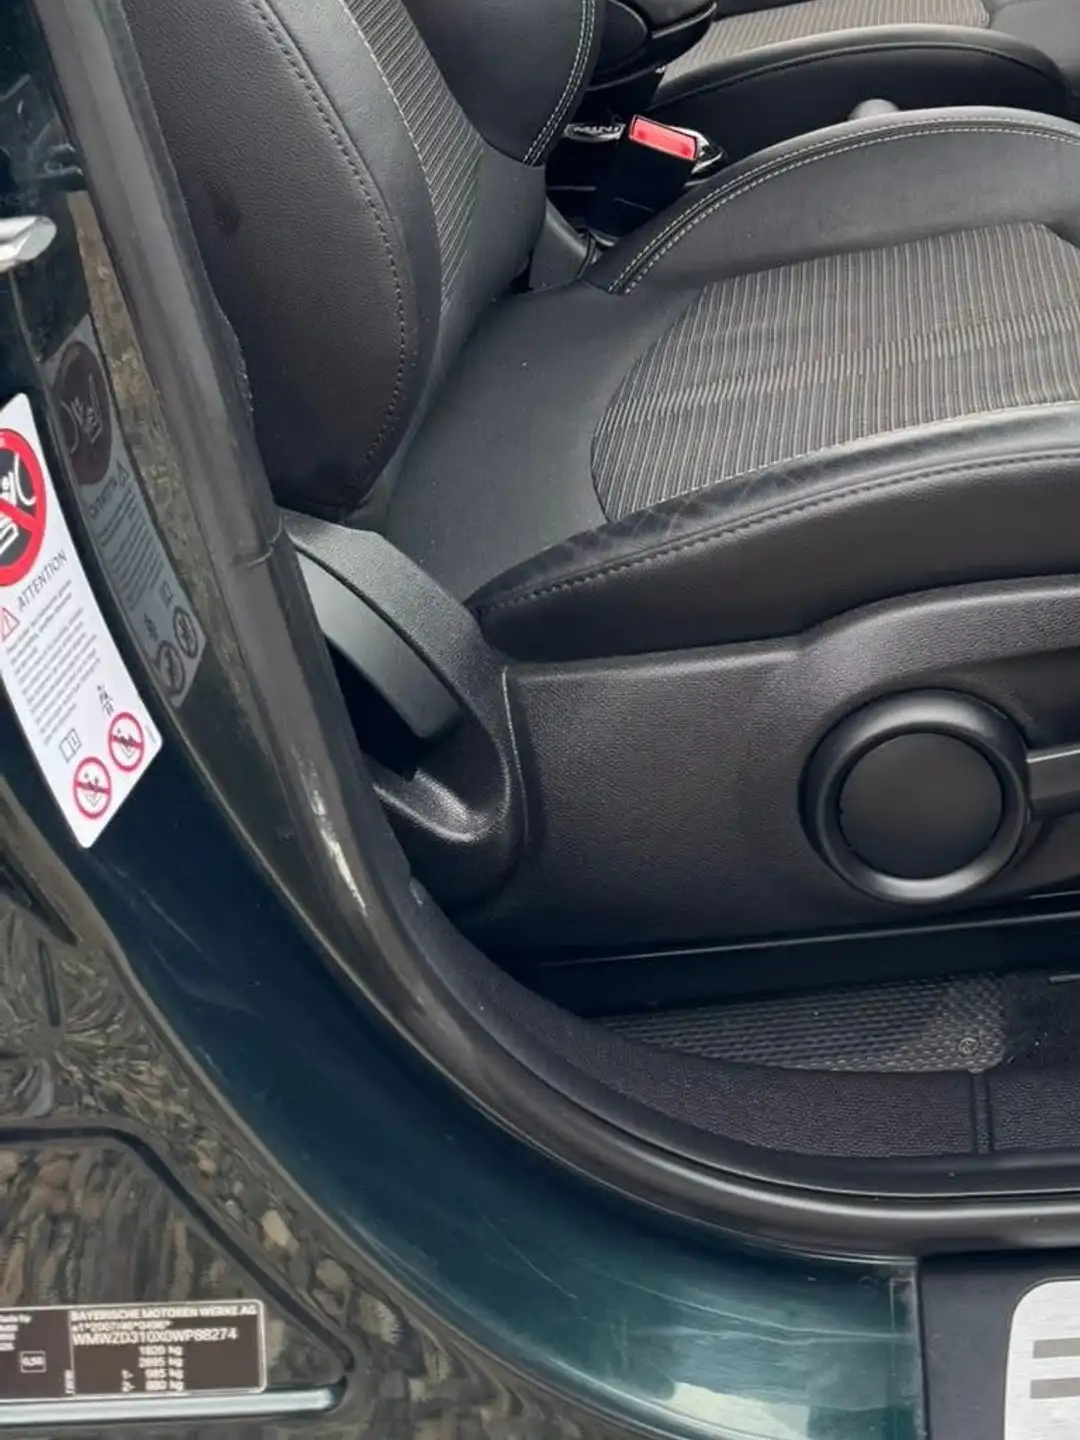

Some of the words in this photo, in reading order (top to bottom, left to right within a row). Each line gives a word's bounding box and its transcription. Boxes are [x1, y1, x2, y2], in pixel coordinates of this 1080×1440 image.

[17, 548, 67, 611] ATTENTION
[142, 1307, 198, 1319] MOTOREN
[240, 1305, 258, 1316] AG
